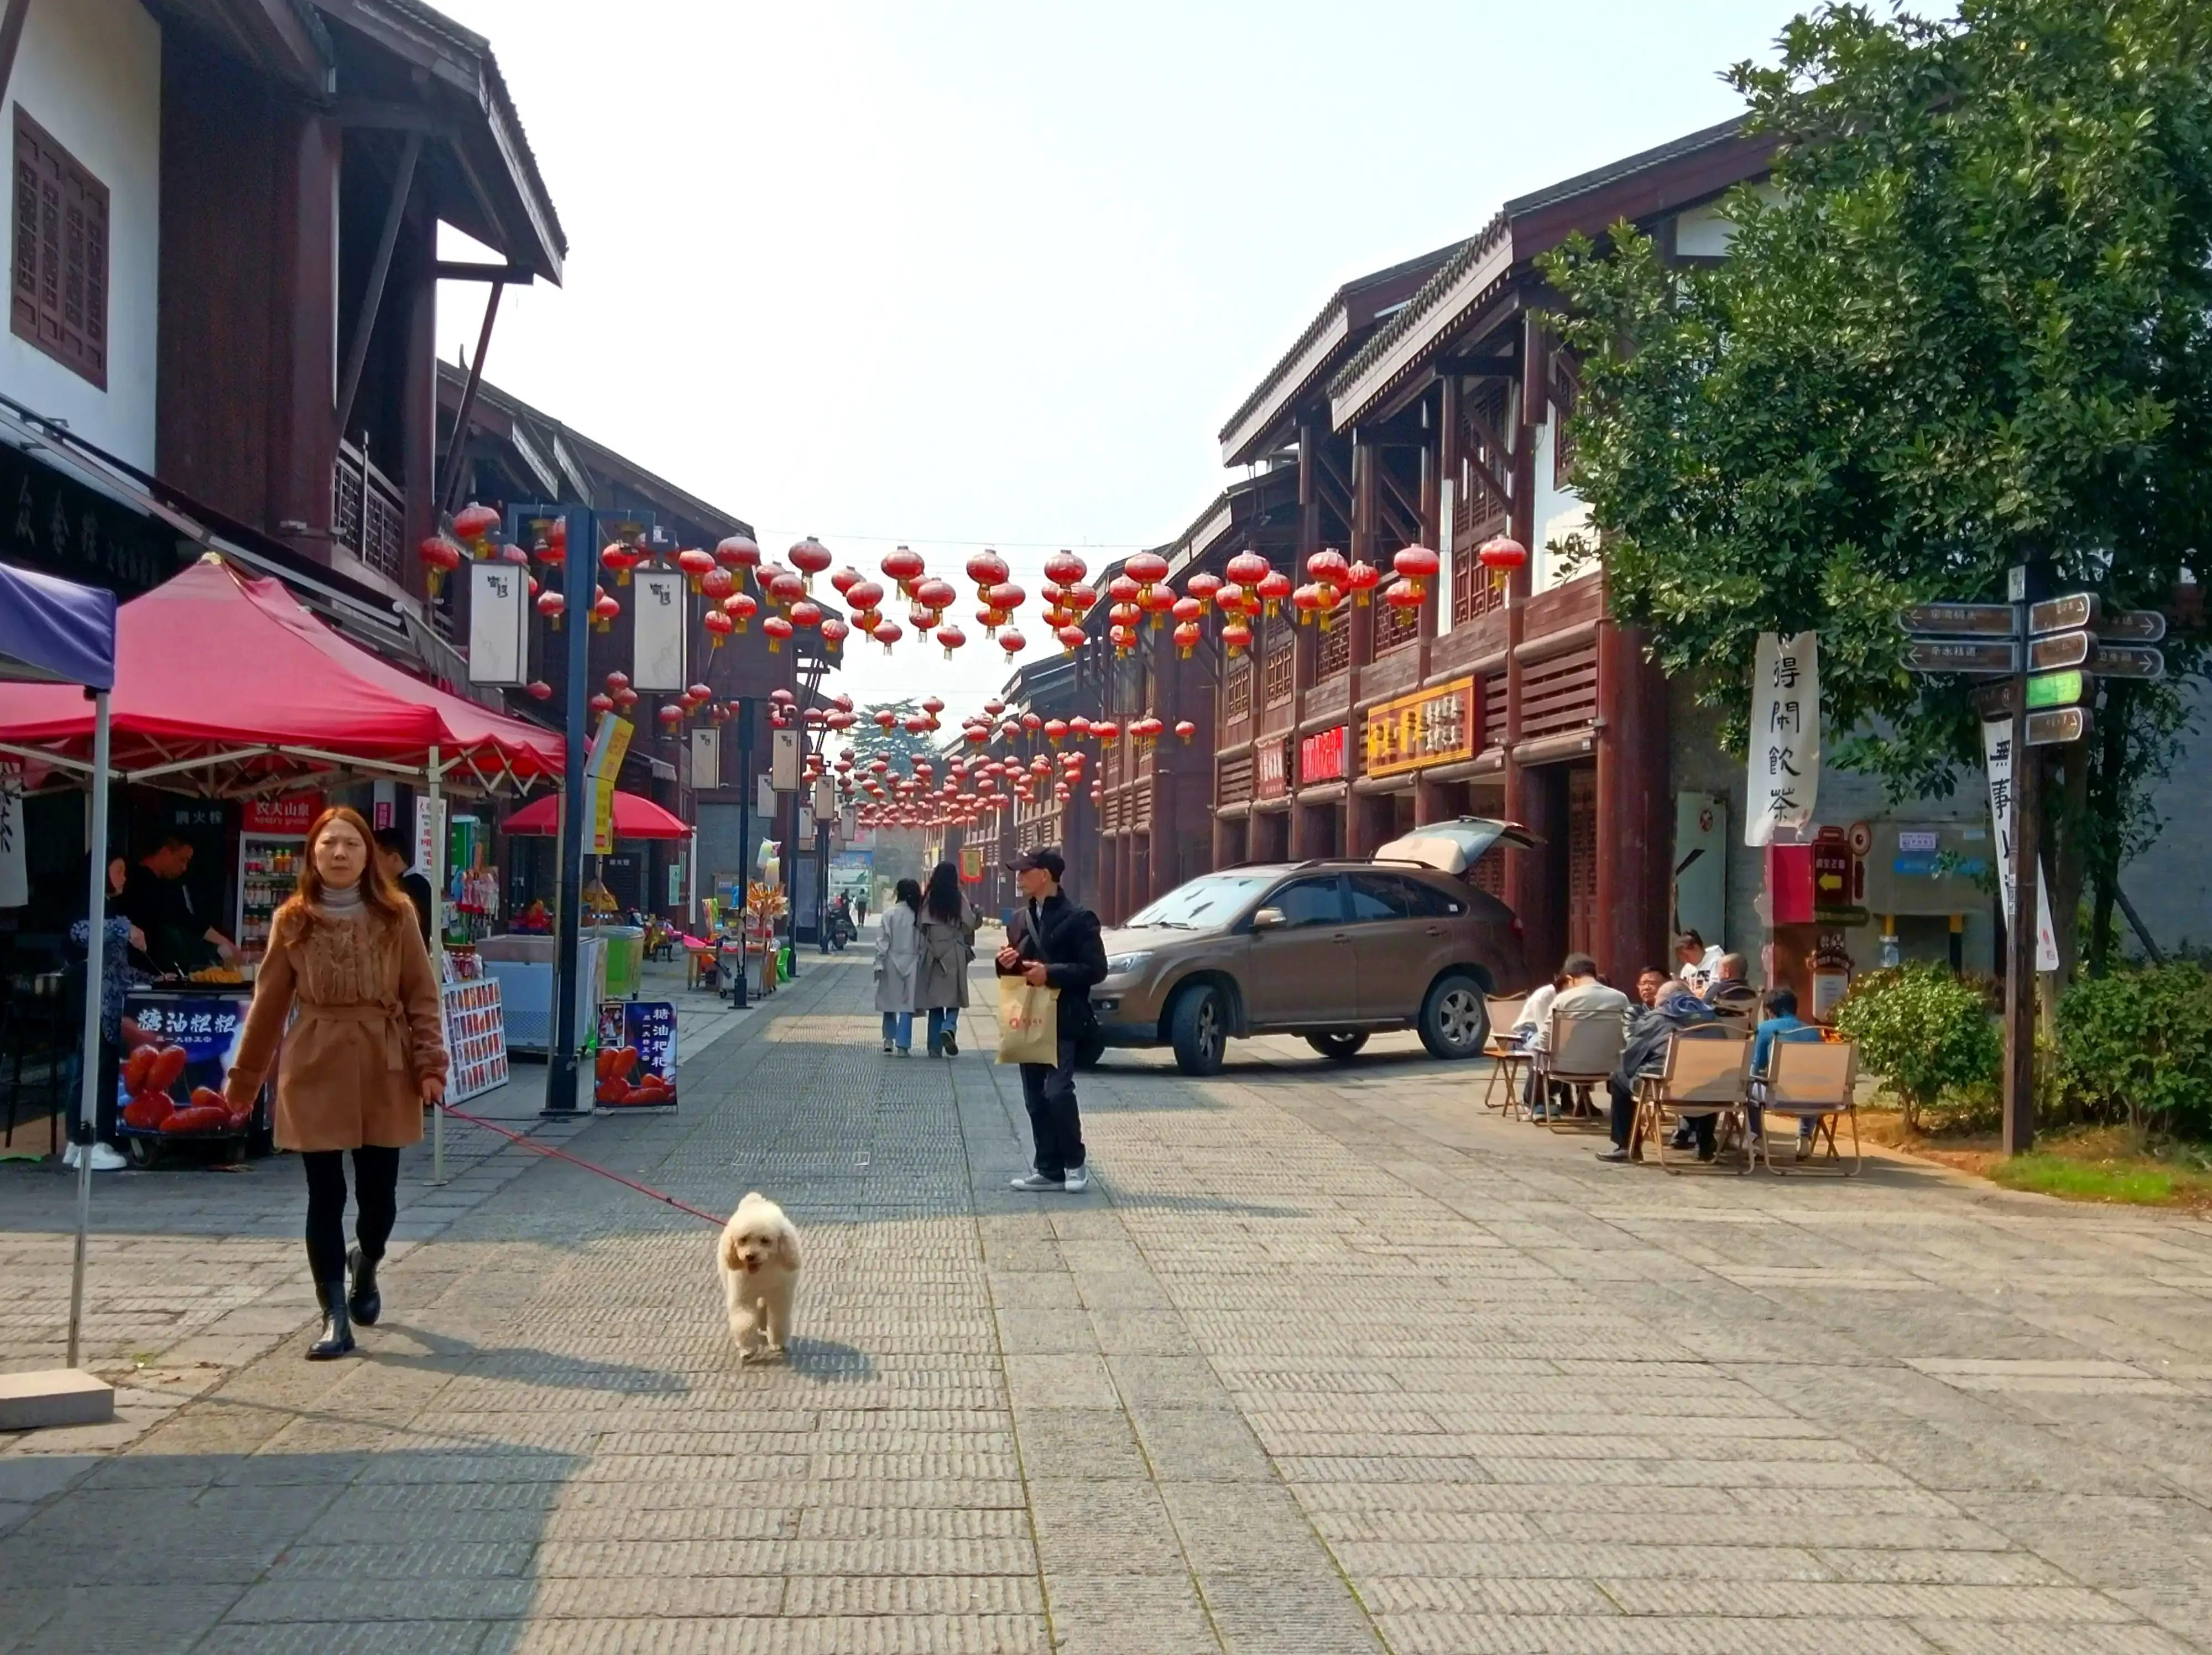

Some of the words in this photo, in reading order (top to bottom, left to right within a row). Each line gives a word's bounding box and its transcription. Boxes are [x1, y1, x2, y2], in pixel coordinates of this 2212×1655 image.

[137, 1007, 236, 1033] 糖油粑粑
[651, 1008, 670, 1068] 糖油粑粑
